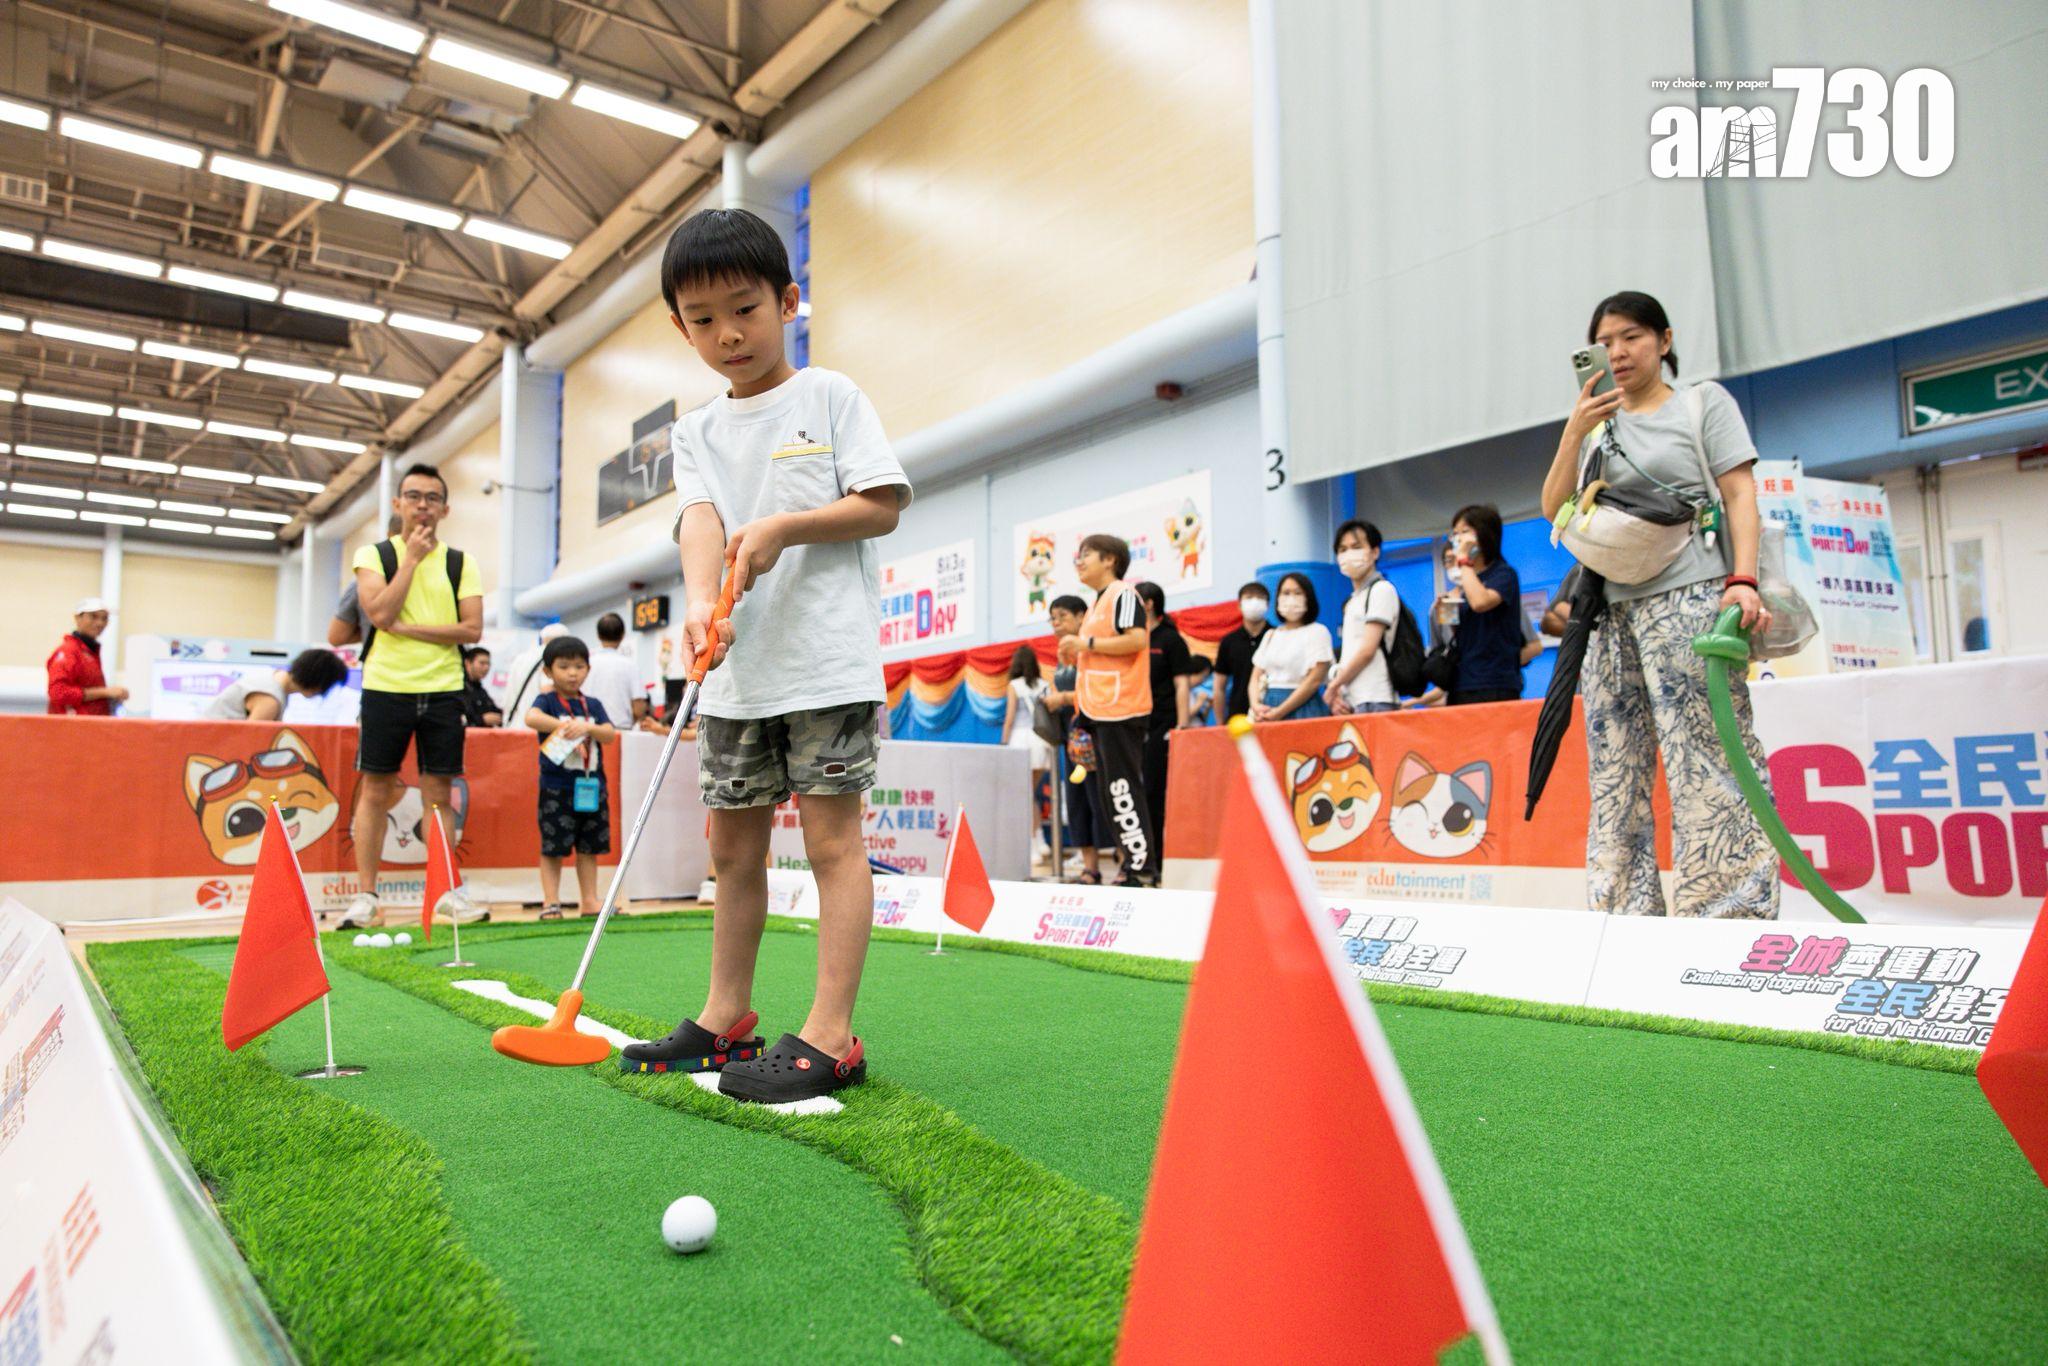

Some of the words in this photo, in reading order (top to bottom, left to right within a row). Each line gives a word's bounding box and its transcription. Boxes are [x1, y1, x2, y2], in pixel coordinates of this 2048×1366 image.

[1266, 448, 1285, 491] 3
[1868, 731, 2048, 809] 全民
[863, 836, 897, 850] ctive
[777, 856, 813, 870] Hea
[1740, 934, 1980, 985] 全城齊運動
[1680, 968, 1767, 992] Coalescing
[1767, 973, 1845, 995] together
[1824, 1013, 1856, 1032] for
[1855, 1016, 1889, 1038] the
[1889, 1019, 1977, 1046] National
[1974, 1026, 1994, 1046] G
